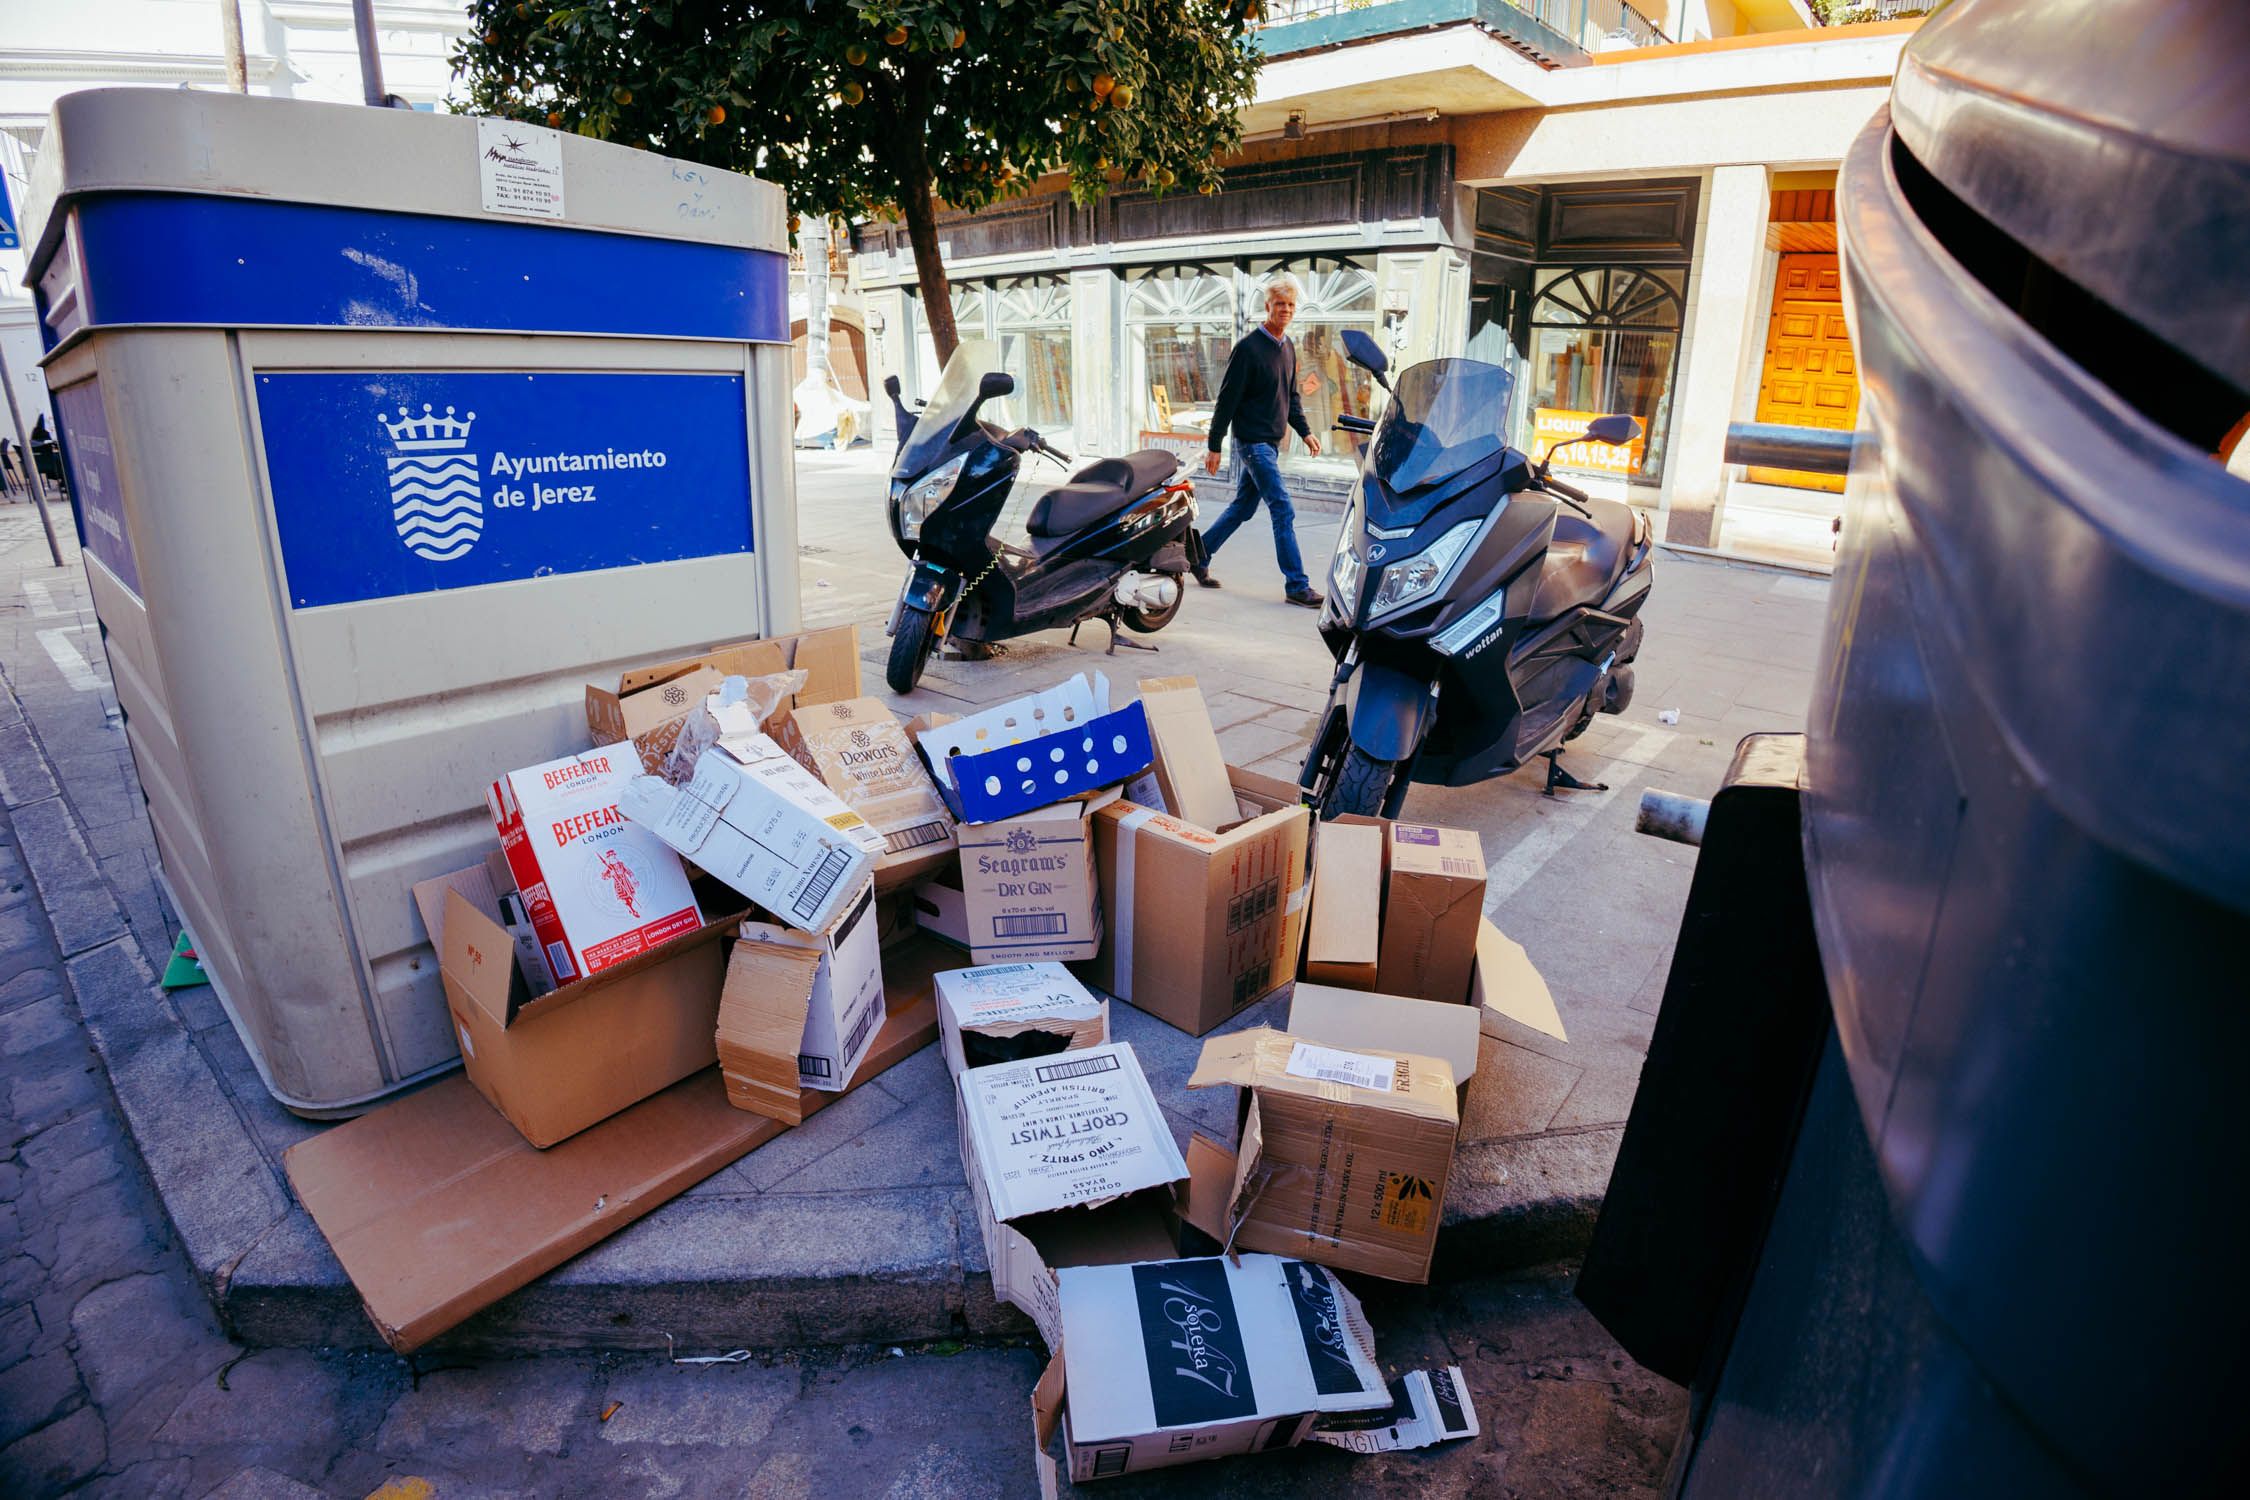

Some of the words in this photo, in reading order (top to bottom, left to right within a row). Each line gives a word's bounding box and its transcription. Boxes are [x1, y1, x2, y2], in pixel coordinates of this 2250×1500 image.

[490, 448, 666, 480] Ayuntamiento
[493, 484, 526, 508] de
[532, 482, 596, 511] Jerez
[1465, 626, 1503, 660] wottan
[839, 744, 898, 766] Dewar's
[543, 756, 612, 790] BEEFEATER
[566, 776, 598, 790] LONDON
[852, 769, 880, 782] White
[878, 764, 905, 777] Label
[552, 804, 632, 848] BEEFEAT
[582, 825, 624, 845] LONDON
[736, 853, 754, 878] Contiene
[978, 854, 1067, 876] Seagram's
[998, 882, 1026, 897] DRY
[1028, 881, 1053, 895] GIN
[647, 926, 672, 940] LONDON
[672, 920, 682, 930] DRY
[684, 916, 694, 924] GIN
[1396, 1060, 1410, 1093] FRAGIL
[1014, 1086, 1057, 1112] APERITIF
[1062, 1084, 1106, 1094] BRITISH
[1070, 1112, 1128, 1134] CROFT
[1010, 1124, 1066, 1146] TWIST
[1042, 1153, 1085, 1164] SPRITZ
[1089, 1140, 1115, 1158] FINO
[1345, 1152, 1354, 1168] OIL
[1072, 1177, 1106, 1188] BYASS
[1341, 1169, 1352, 1192] OLIVE
[1374, 1184, 1386, 1201] 500
[1370, 1208, 1381, 1220] 12
[1331, 1222, 1342, 1248] ETRA
